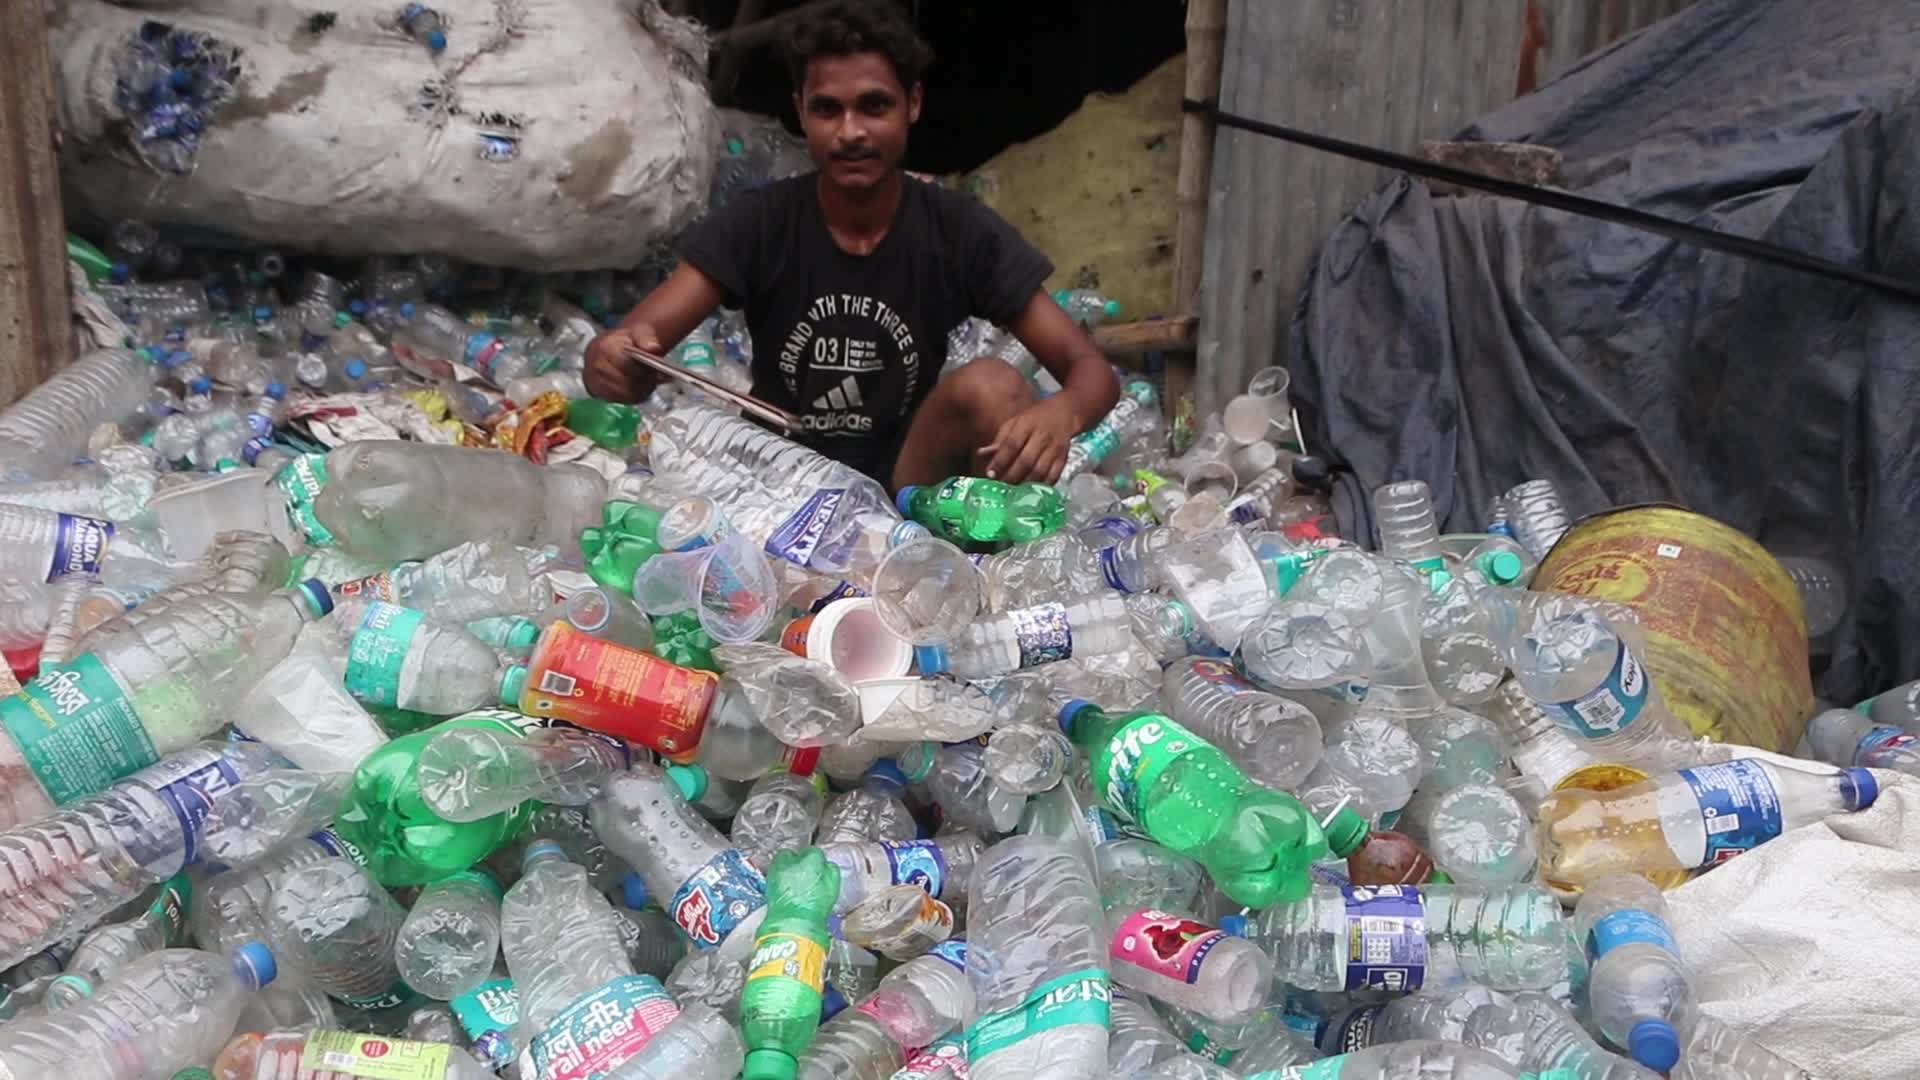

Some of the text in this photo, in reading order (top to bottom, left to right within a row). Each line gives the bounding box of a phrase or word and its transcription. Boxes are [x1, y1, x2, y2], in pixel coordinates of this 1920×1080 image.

[779, 320, 814, 374] BRAND
[842, 293, 872, 318] THE
[873, 300, 913, 351] THREE
[814, 336, 839, 363] 03
[800, 411, 873, 431] adidas
[82, 525, 99, 563] AQUA
[547, 1044, 586, 1078] rail
[585, 1010, 636, 1058] neer
